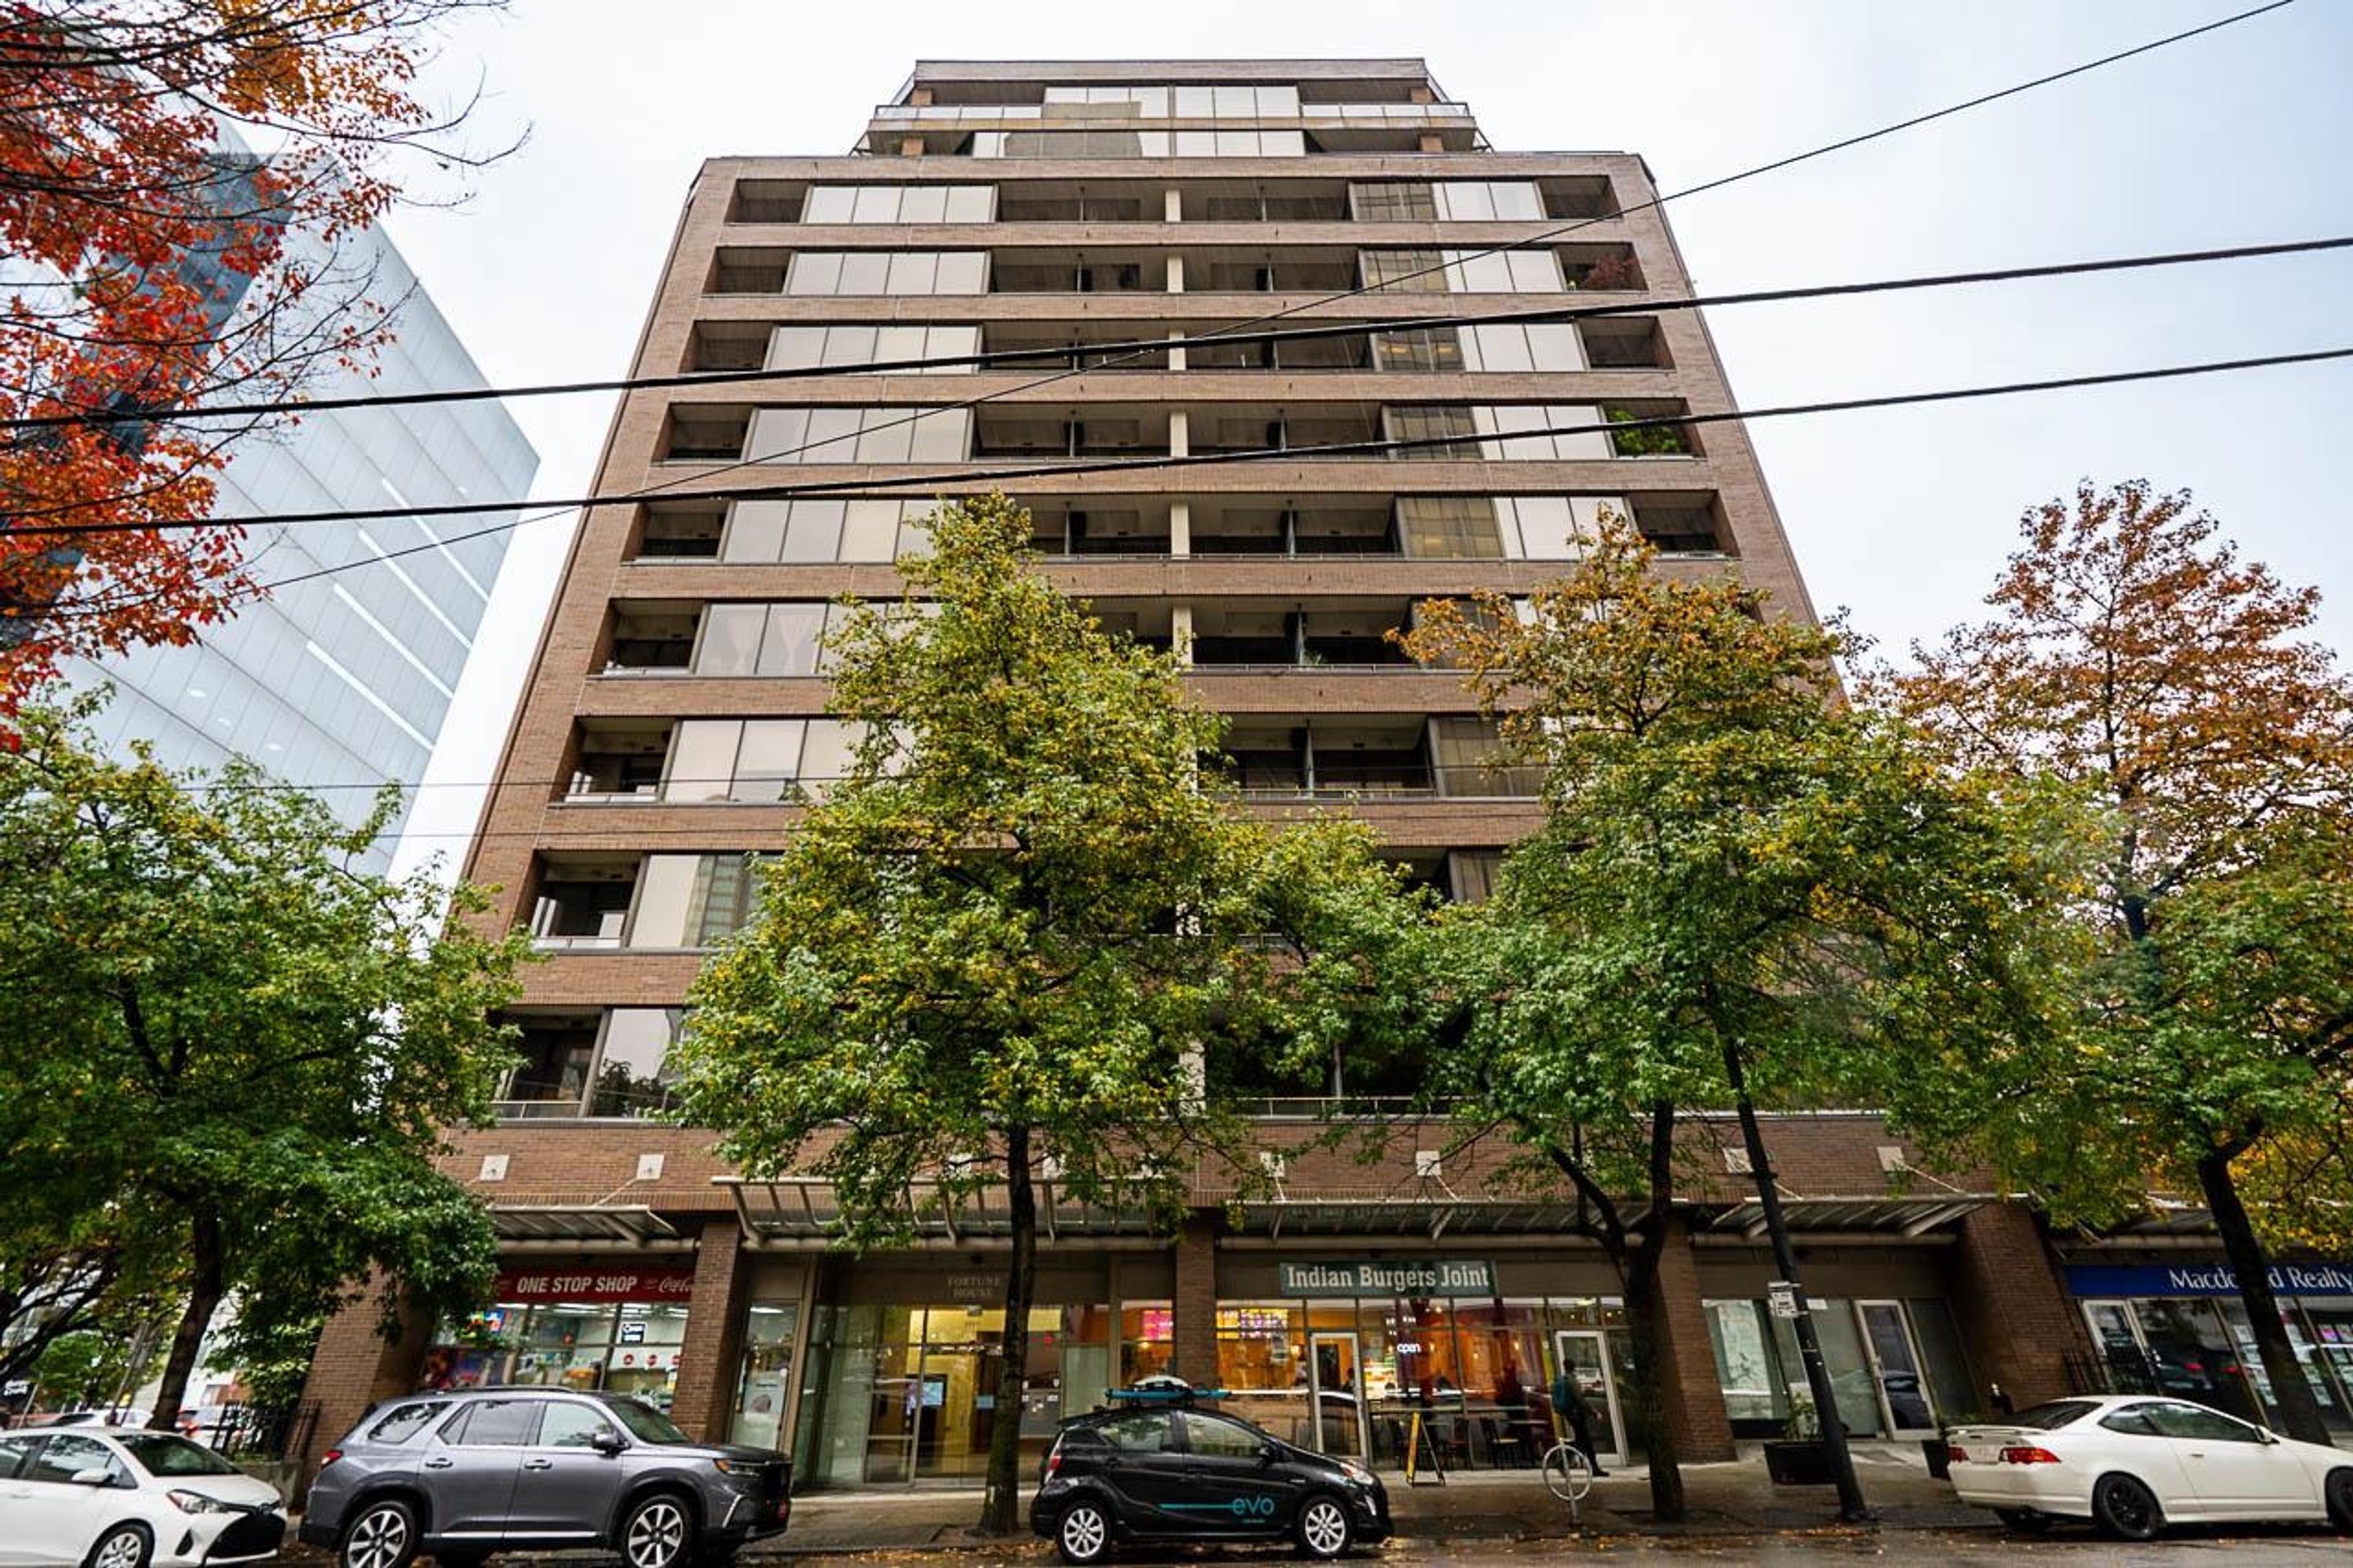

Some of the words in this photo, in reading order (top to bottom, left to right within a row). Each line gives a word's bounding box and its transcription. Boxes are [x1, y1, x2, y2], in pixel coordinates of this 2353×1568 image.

[517, 1277, 549, 1293] ONE
[552, 1277, 592, 1293] STOP
[596, 1276, 637, 1293] SHOP
[1288, 1266, 1353, 1287] Indian
[1358, 1266, 1436, 1292] Burgers
[1441, 1265, 1489, 1287] Joint
[2286, 1267, 2353, 1293] Realty
[1233, 1494, 1275, 1515] evo
